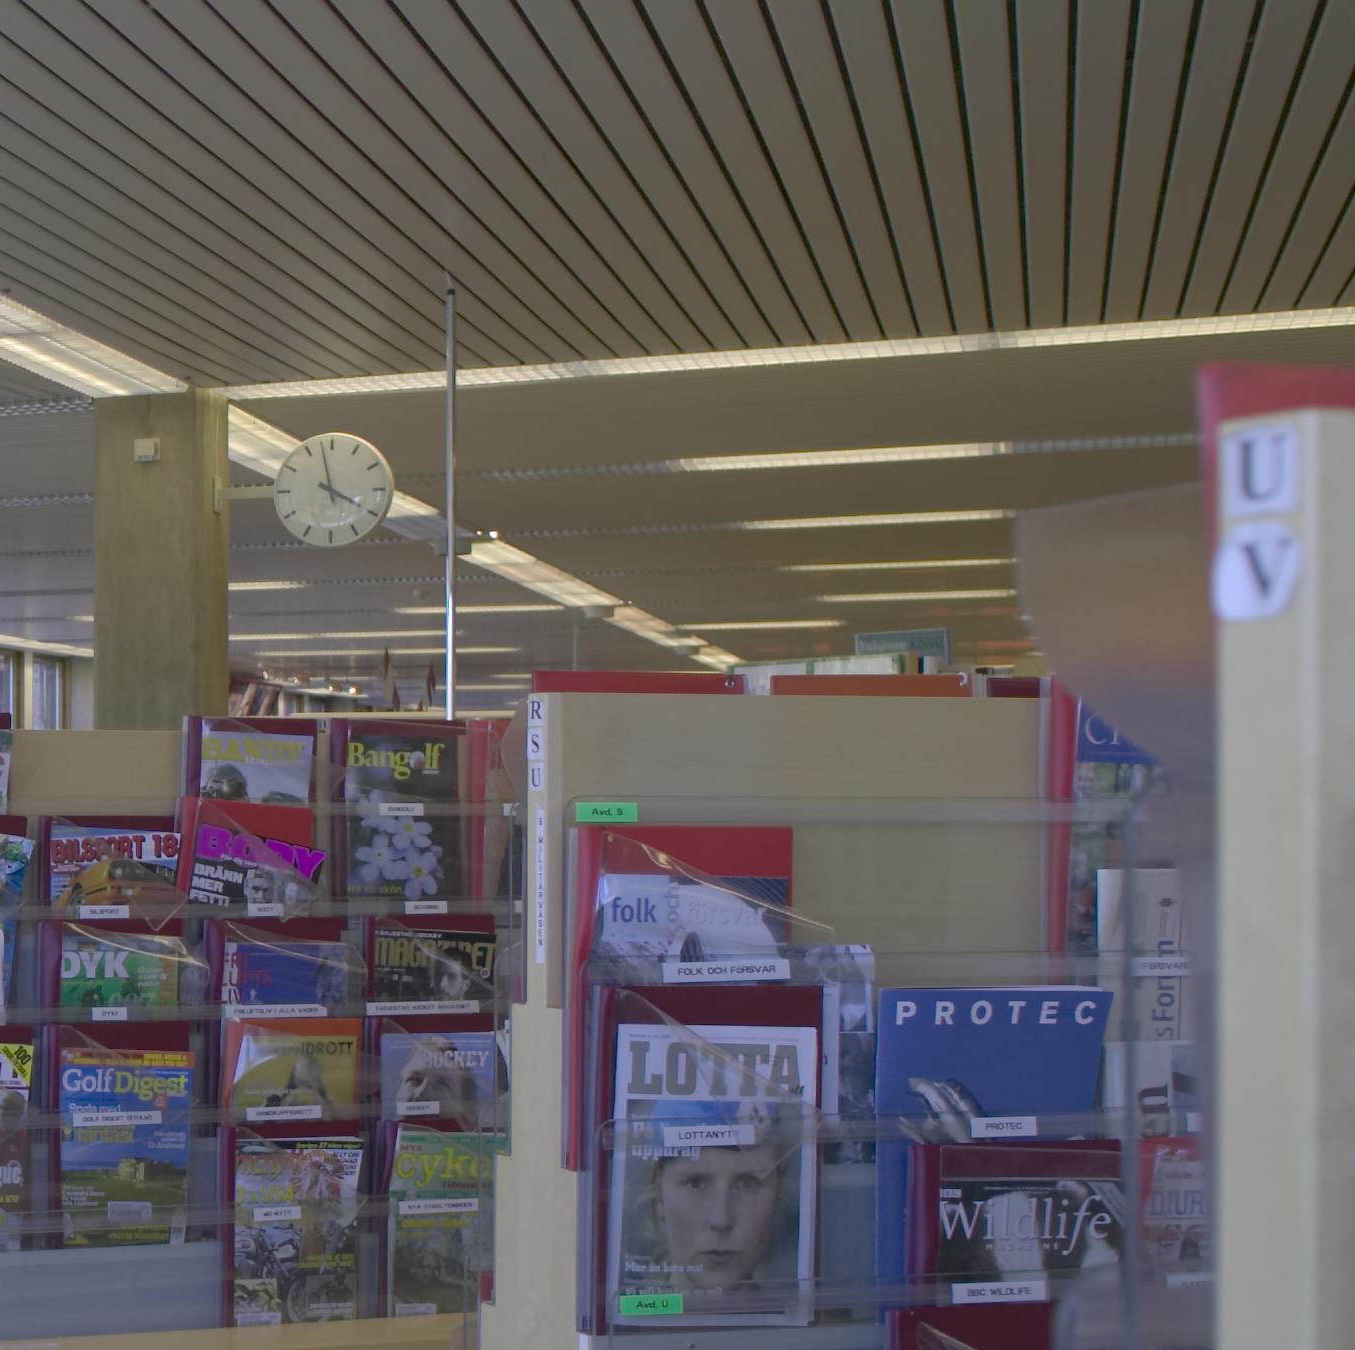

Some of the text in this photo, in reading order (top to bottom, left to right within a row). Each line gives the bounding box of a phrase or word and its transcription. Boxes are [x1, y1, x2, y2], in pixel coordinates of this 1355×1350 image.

[1240, 434, 1285, 502] U
[1242, 537, 1294, 601] V
[530, 701, 542, 720] R
[531, 734, 539, 753] S
[531, 768, 541, 787] U
[52, 834, 179, 863] BILSPORT 18
[195, 823, 328, 881] BODY
[191, 876, 225, 893] MER
[193, 863, 244, 883] BRÄNN
[611, 897, 658, 924] folk
[60, 951, 129, 979] DYK
[678, 967, 703, 977] FOLK
[708, 965, 728, 975] OCH
[894, 1000, 1098, 1026] PROTEC
[13, 1045, 32, 1066] 100
[627, 1041, 803, 1096] LOTTA
[62, 1068, 188, 1100] Golf Digest
[985, 1121, 1023, 1132] PROTEC
[939, 1195, 1111, 1256] Wildlife
[967, 1287, 1032, 1297] BBC WILDLIFE
[636, 1301, 658, 1310] Avd.
